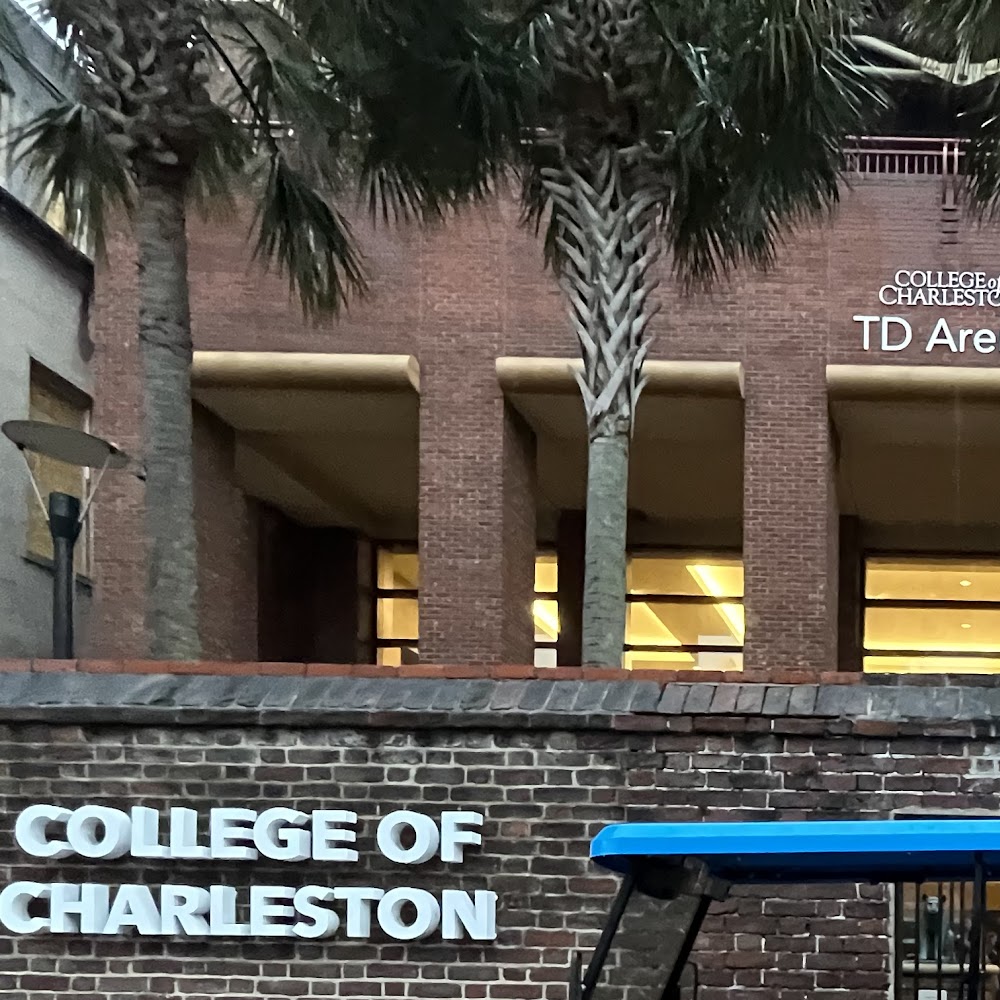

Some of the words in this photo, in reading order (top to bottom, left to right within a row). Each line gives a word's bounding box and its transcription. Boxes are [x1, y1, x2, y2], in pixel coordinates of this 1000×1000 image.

[894, 269, 986, 289] COLLEGE
[852, 315, 913, 352] TD
[15, 803, 359, 862] COLLEGE
[376, 809, 484, 865] OF
[0, 880, 498, 941] CHARLESTON
